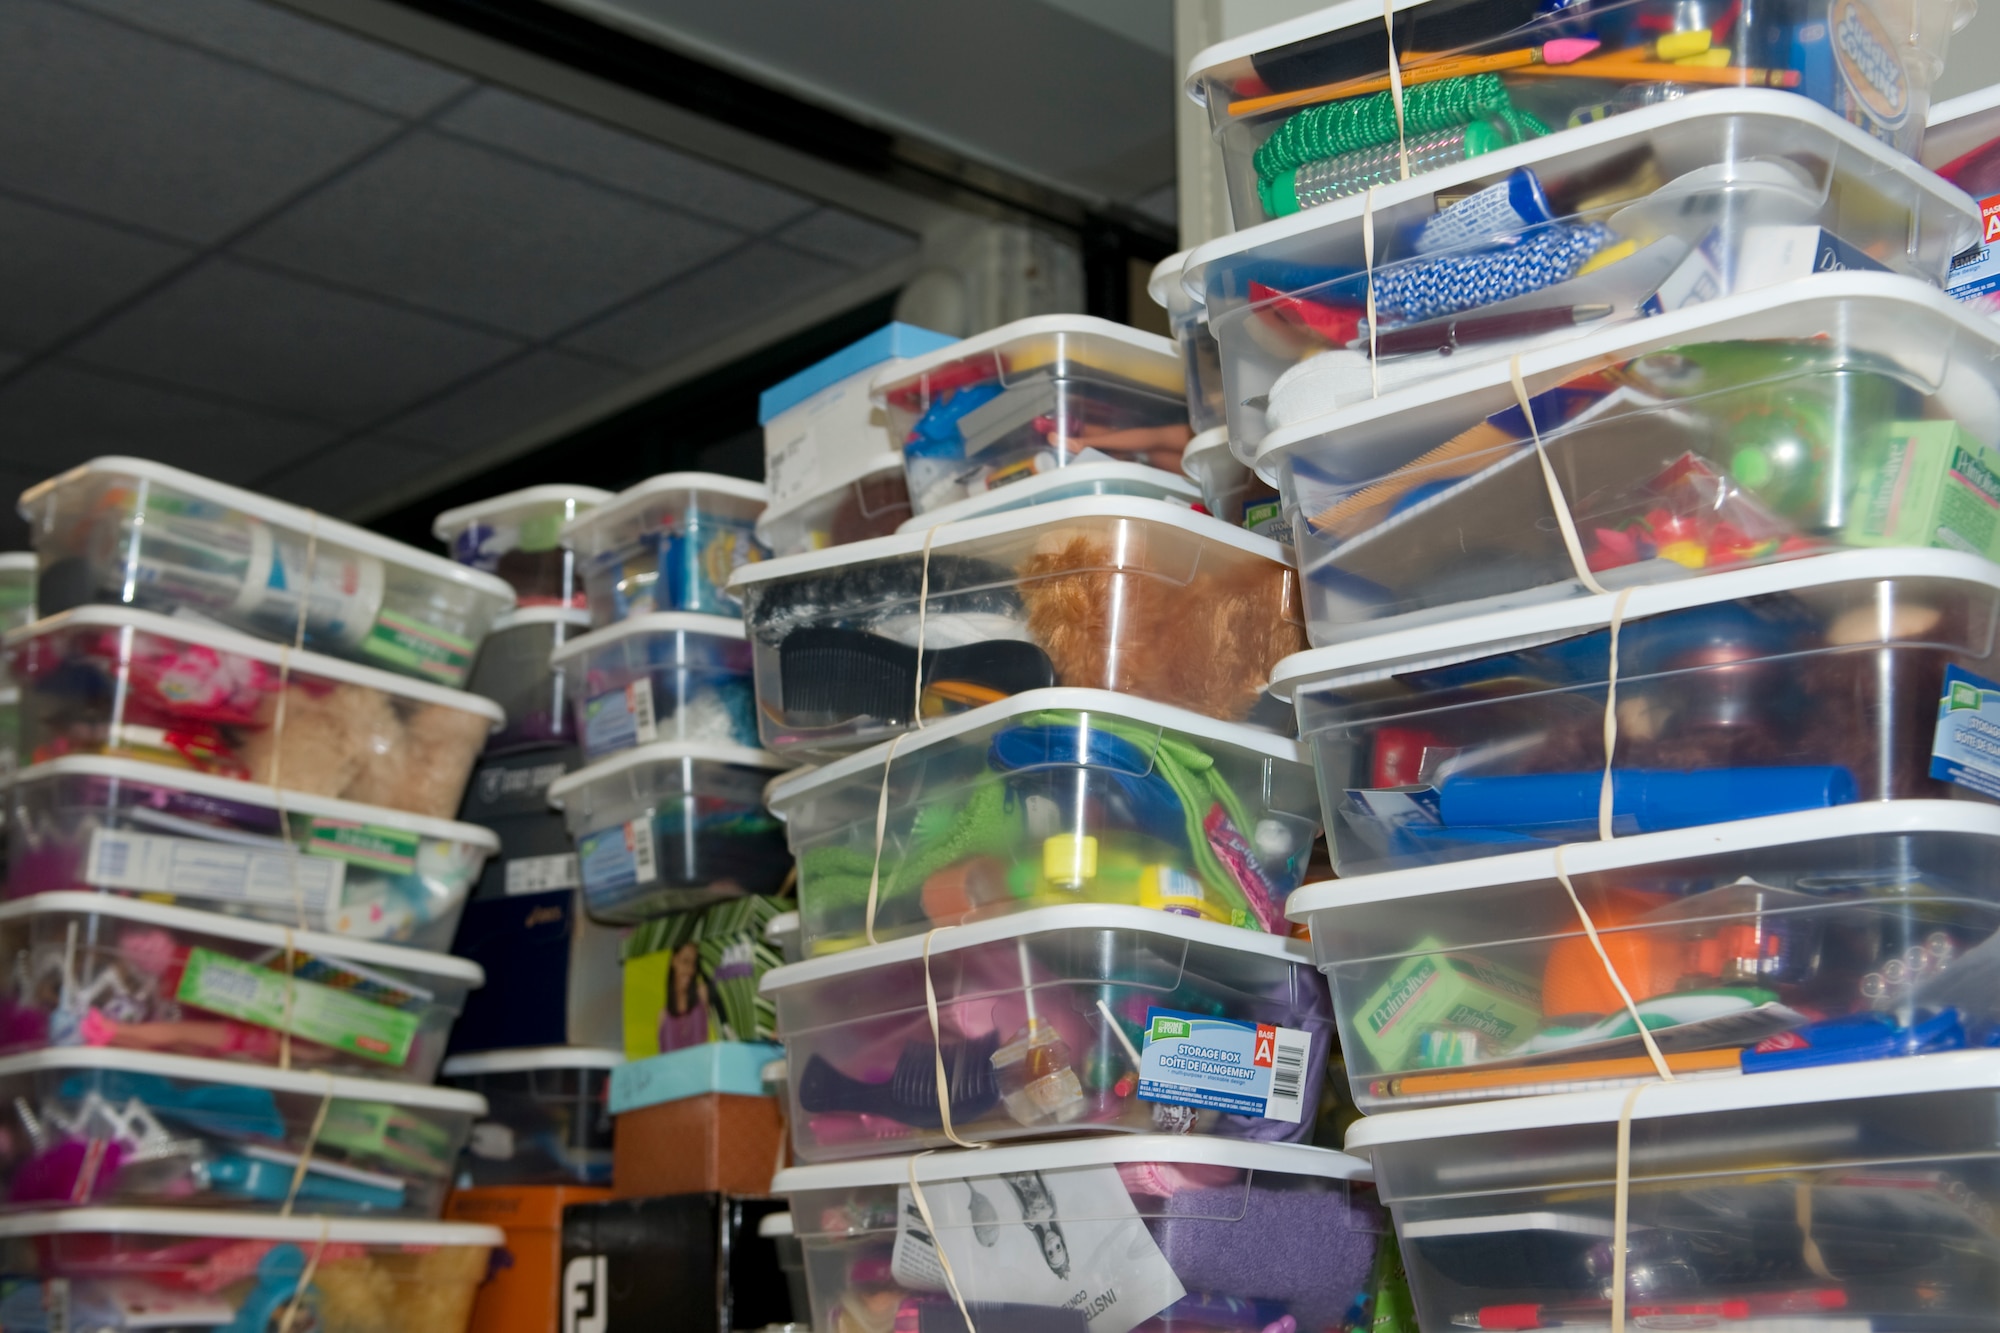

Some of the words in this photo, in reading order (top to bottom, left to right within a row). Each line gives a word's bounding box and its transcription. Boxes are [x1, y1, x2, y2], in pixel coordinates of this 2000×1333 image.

[1373, 964, 1430, 1028] Palmolive
[1450, 1005, 1508, 1039] Palmolive
[1258, 1030, 1274, 1039] BASE
[1178, 1044, 1219, 1060] STORAGE
[1221, 1050, 1240, 1063] BOX
[1255, 1039, 1272, 1063] A
[1160, 1055, 1186, 1069] BOÎTE
[1187, 1060, 1199, 1071] DE
[1201, 1062, 1255, 1080] RANGEMENT
[1061, 1289, 1087, 1311] CONT
[1085, 1288, 1117, 1322] INSTR
